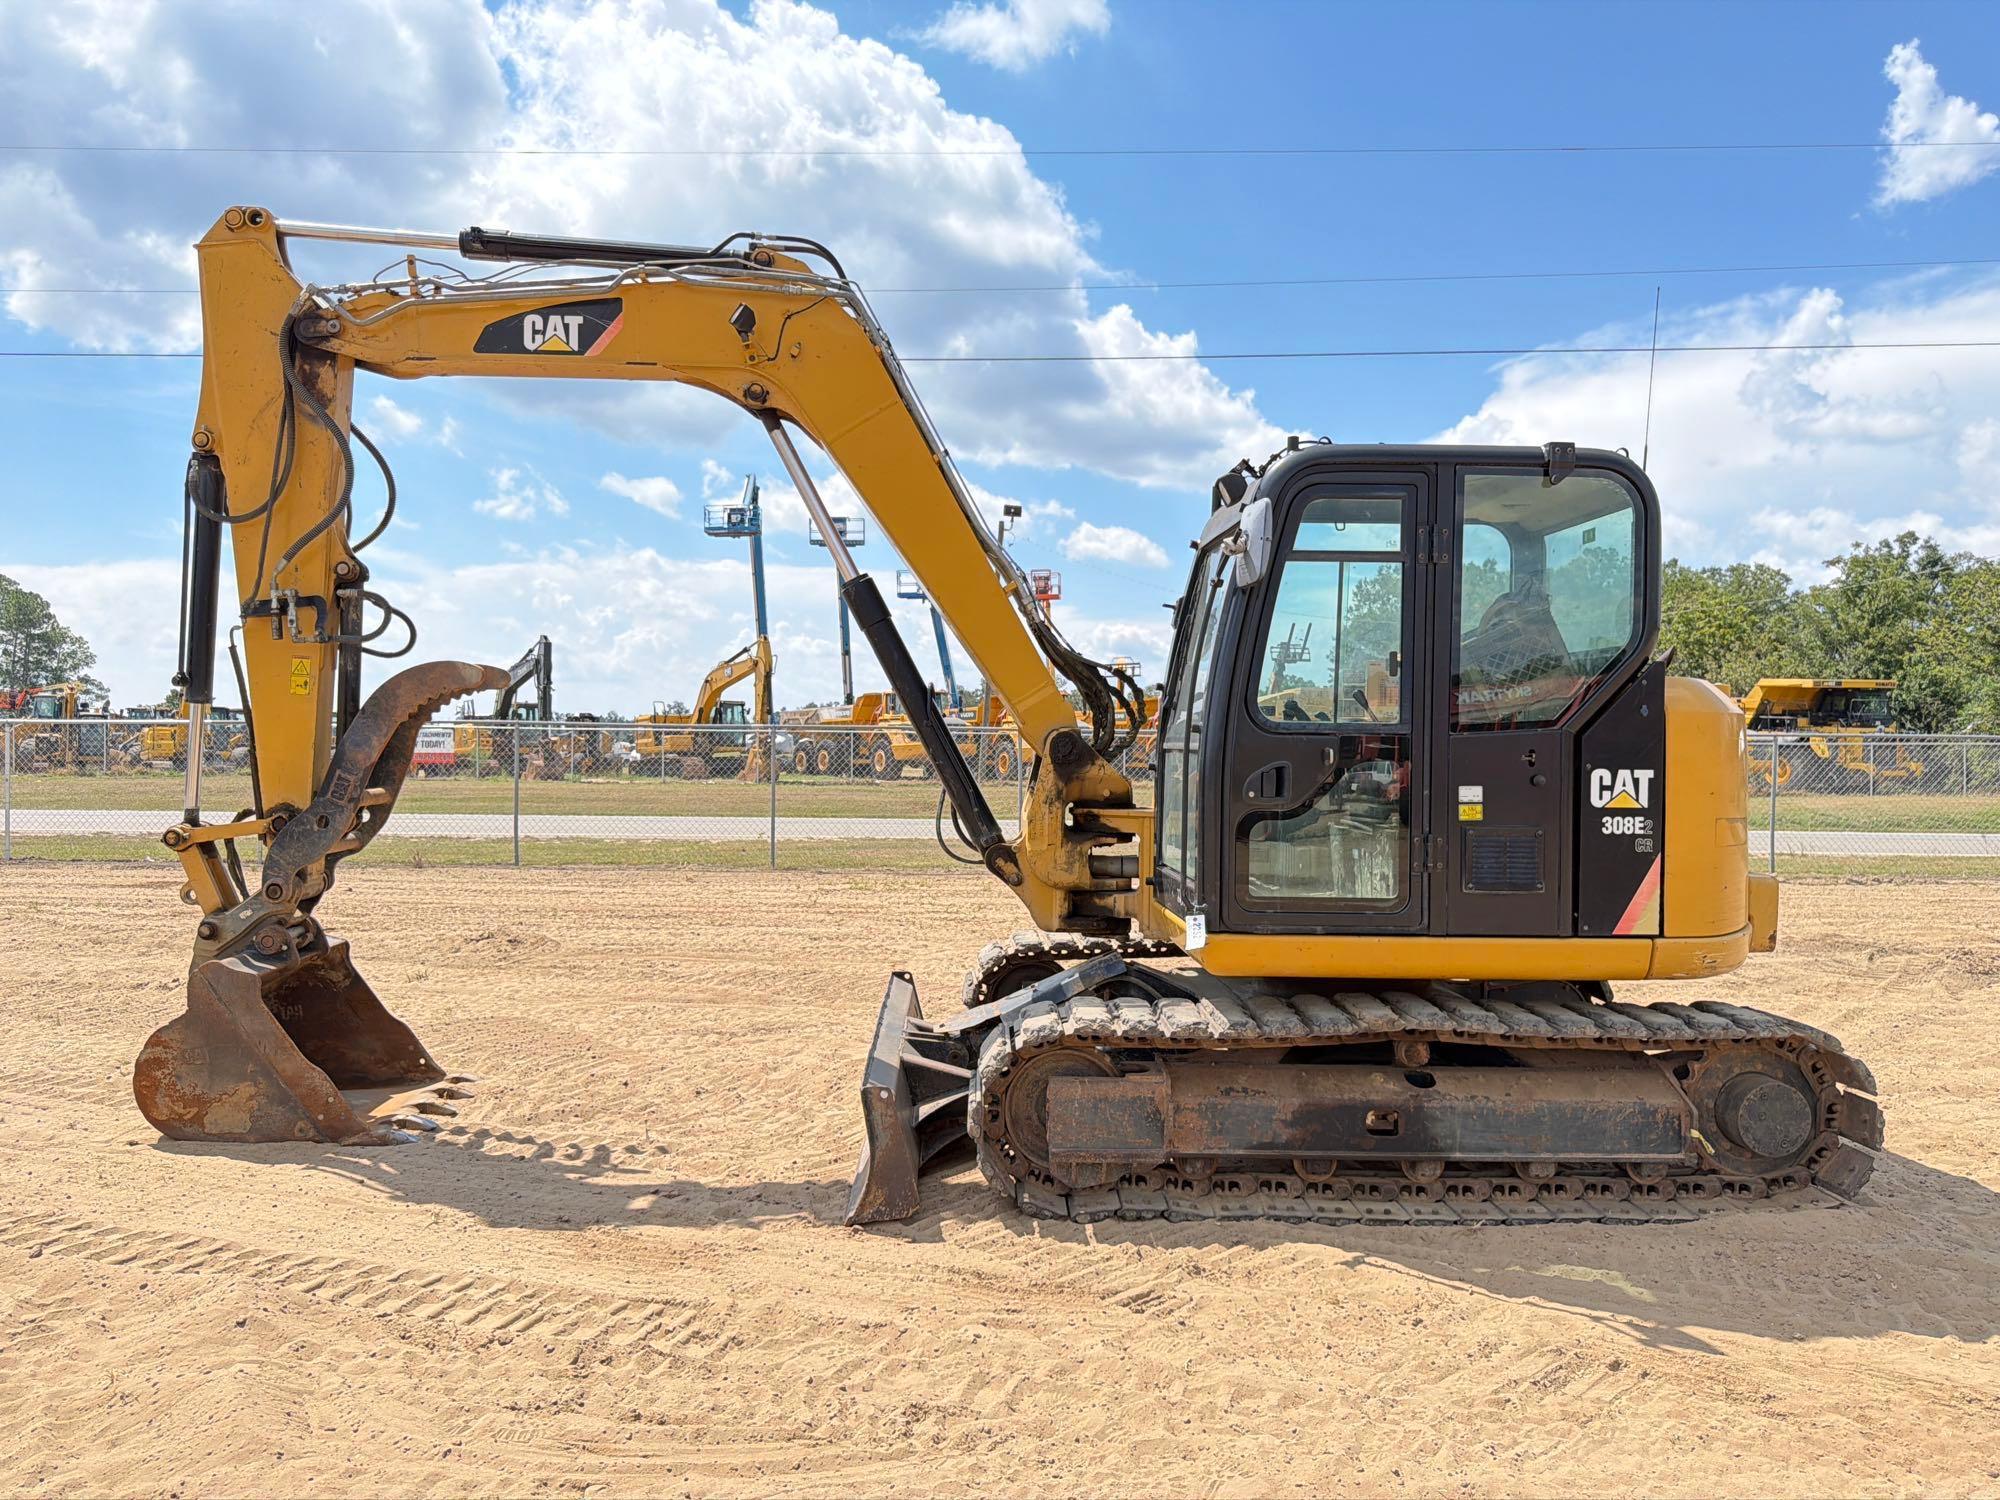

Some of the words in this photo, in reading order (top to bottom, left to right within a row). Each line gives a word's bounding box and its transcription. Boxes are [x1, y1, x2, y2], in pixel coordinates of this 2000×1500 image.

[523, 314, 583, 351] CAT
[421, 740, 445, 748] TODAY!
[330, 773, 352, 801] CAT
[1590, 768, 1654, 808] CAT
[1601, 816, 1653, 835] 308E2
[1634, 838, 1653, 852] CR
